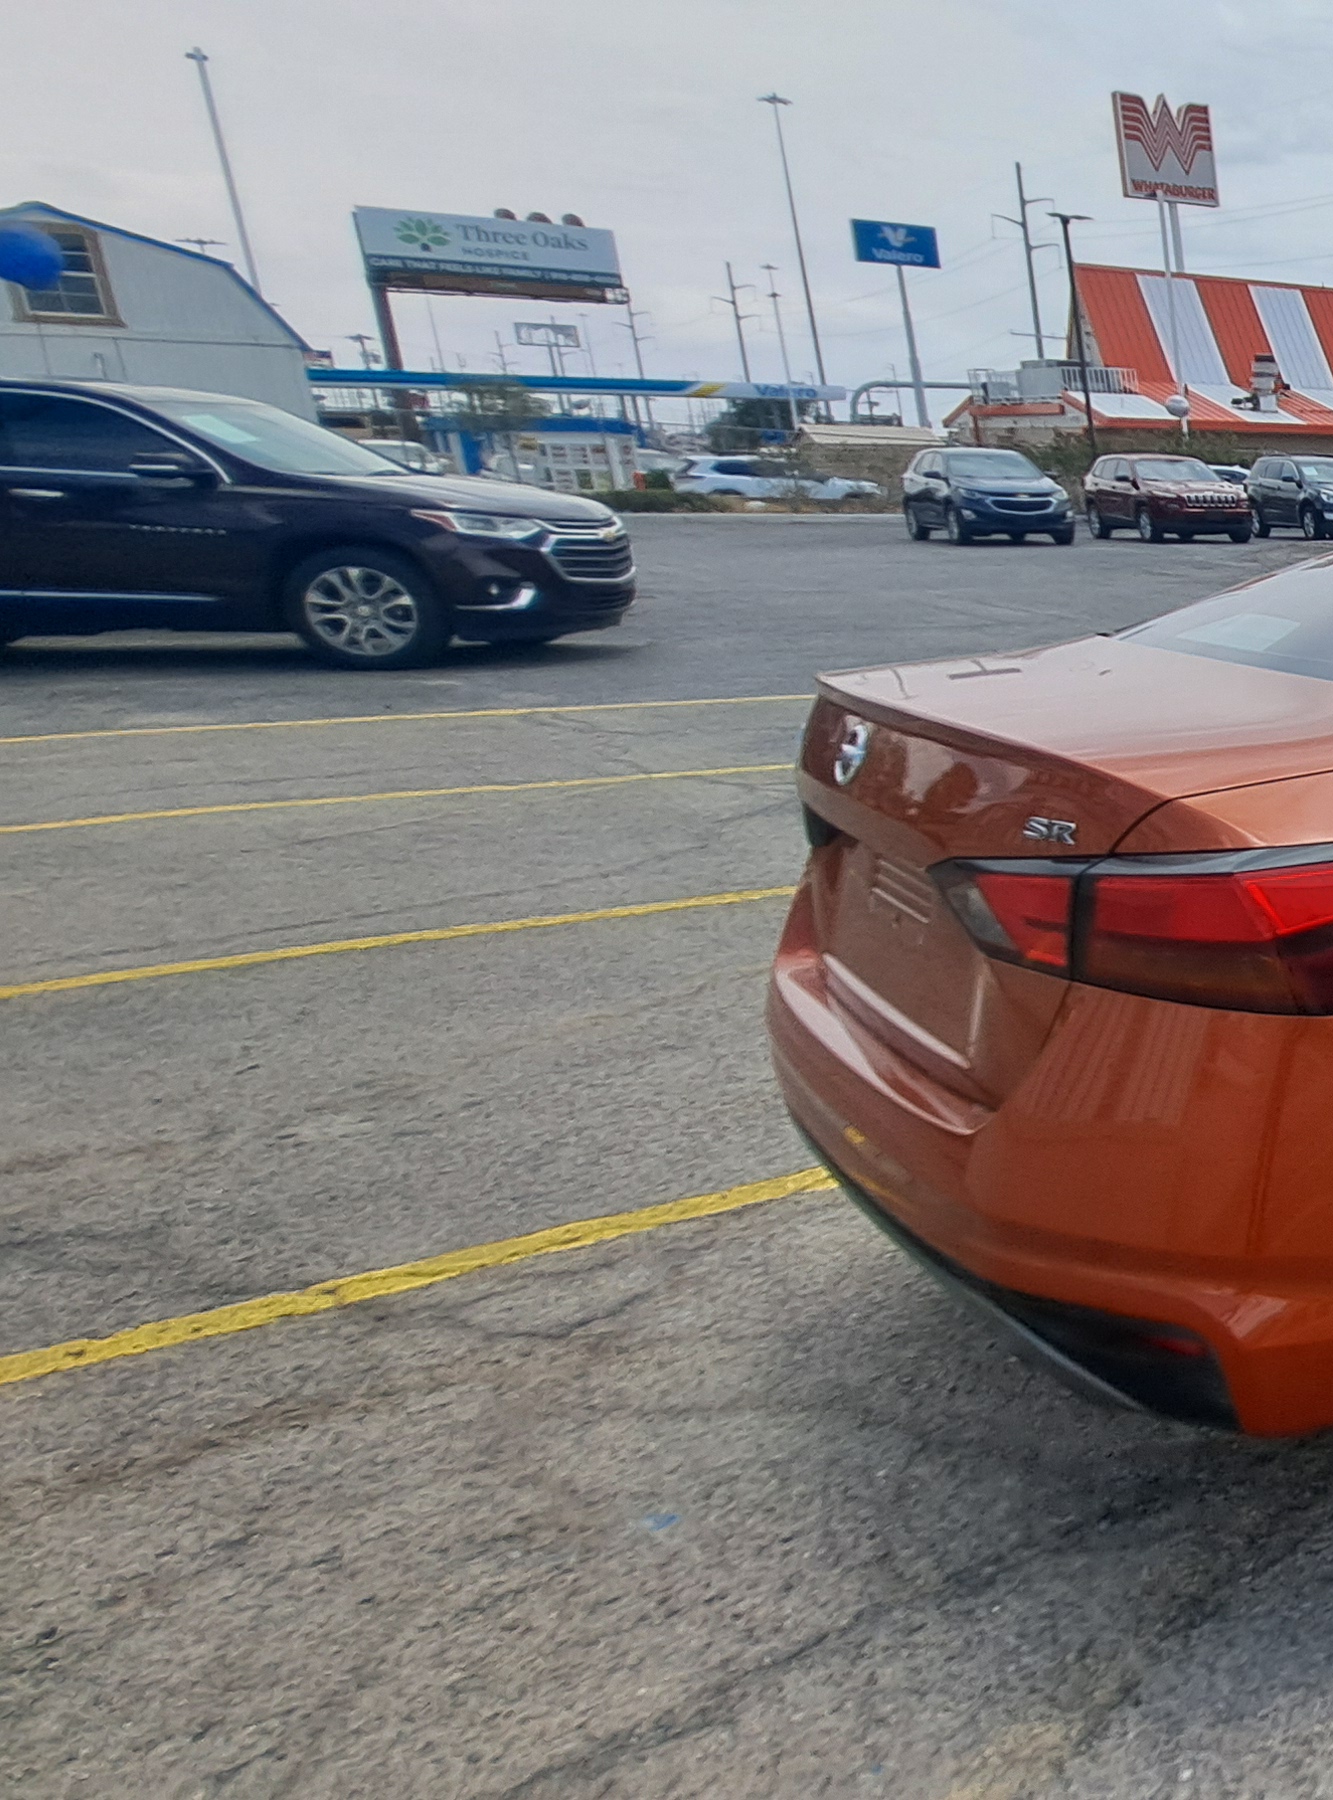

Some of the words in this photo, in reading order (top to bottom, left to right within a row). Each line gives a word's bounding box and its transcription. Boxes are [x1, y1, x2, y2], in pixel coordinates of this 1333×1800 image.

[456, 223, 528, 247] Three
[532, 230, 590, 252] Oaks
[462, 246, 530, 261] HOSPICE
[871, 246, 925, 263] Valero
[1022, 815, 1077, 846] SR
